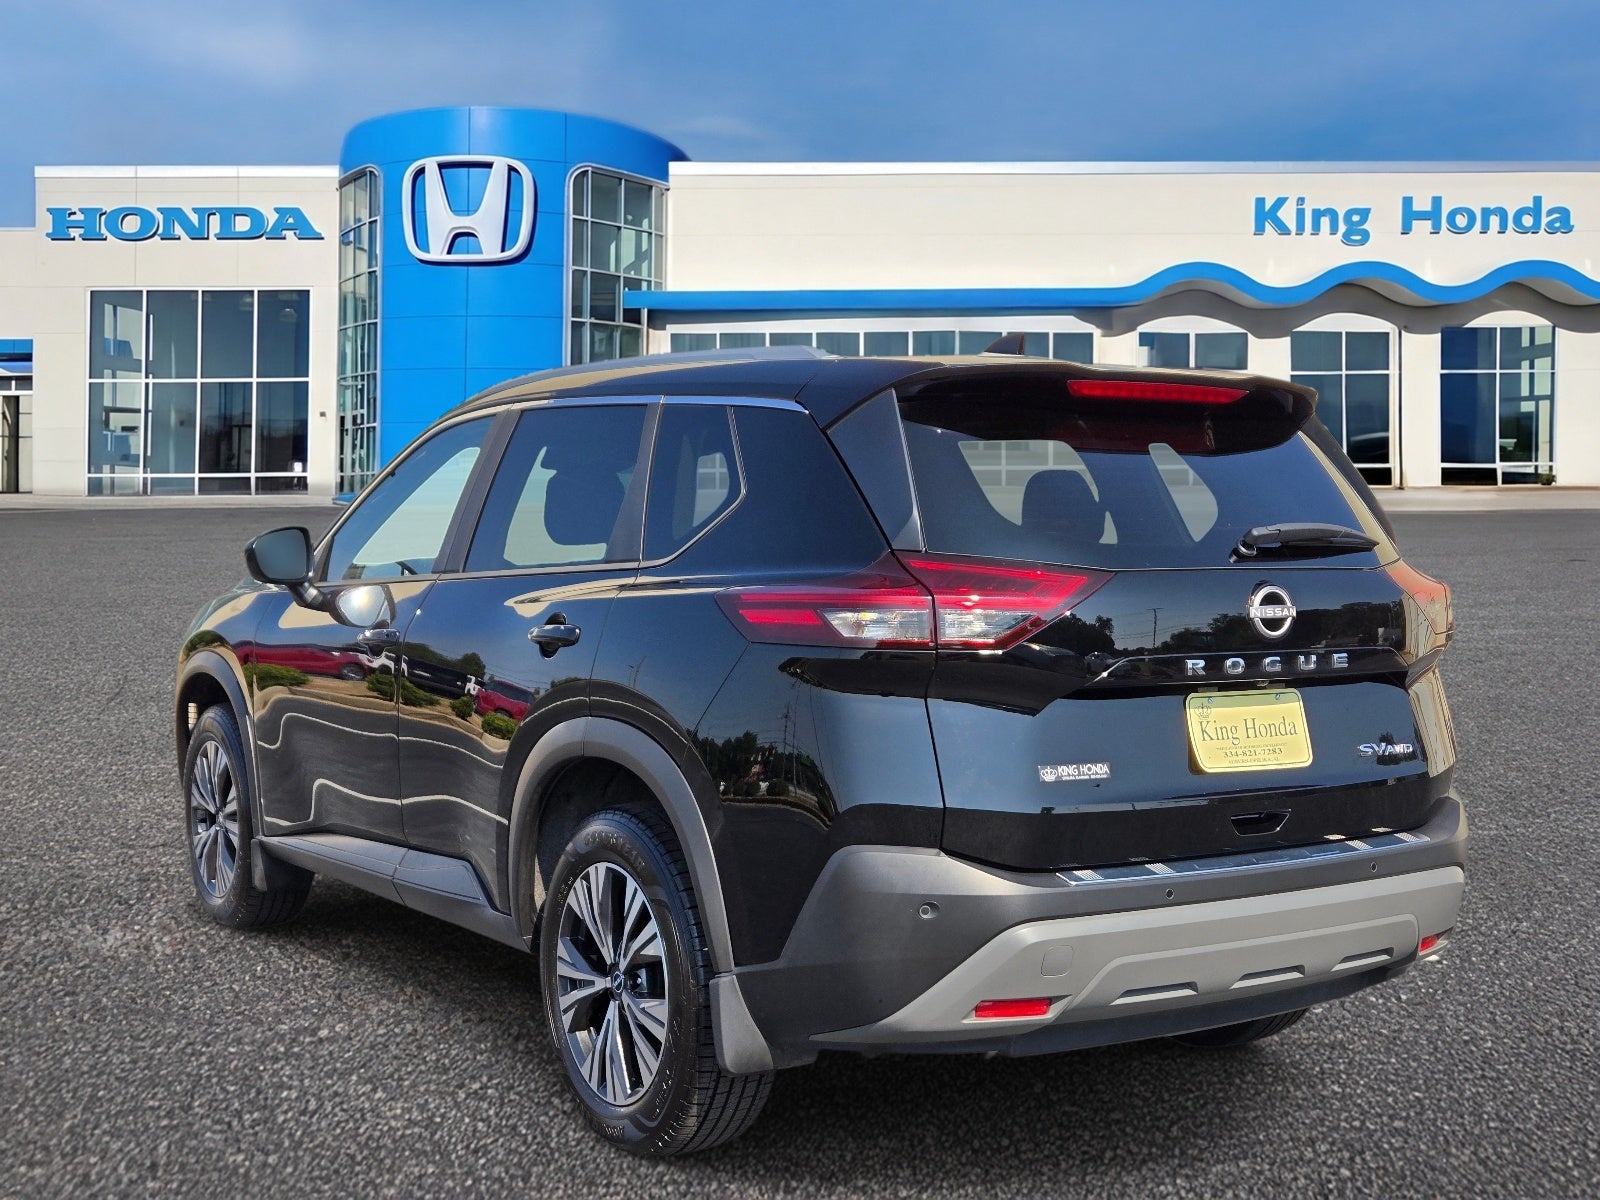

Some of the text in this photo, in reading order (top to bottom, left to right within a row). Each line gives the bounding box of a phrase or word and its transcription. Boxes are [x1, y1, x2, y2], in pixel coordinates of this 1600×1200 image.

[46, 206, 324, 241] HONDA
[1254, 195, 1575, 246] King Honda
[1251, 607, 1296, 618] NISSAN
[1184, 652, 1349, 676] ROGUE
[1198, 716, 1298, 745] King Honda
[1223, 747, 1283, 759] 334-821-7283
[1057, 763, 1109, 776] KING HONDA
